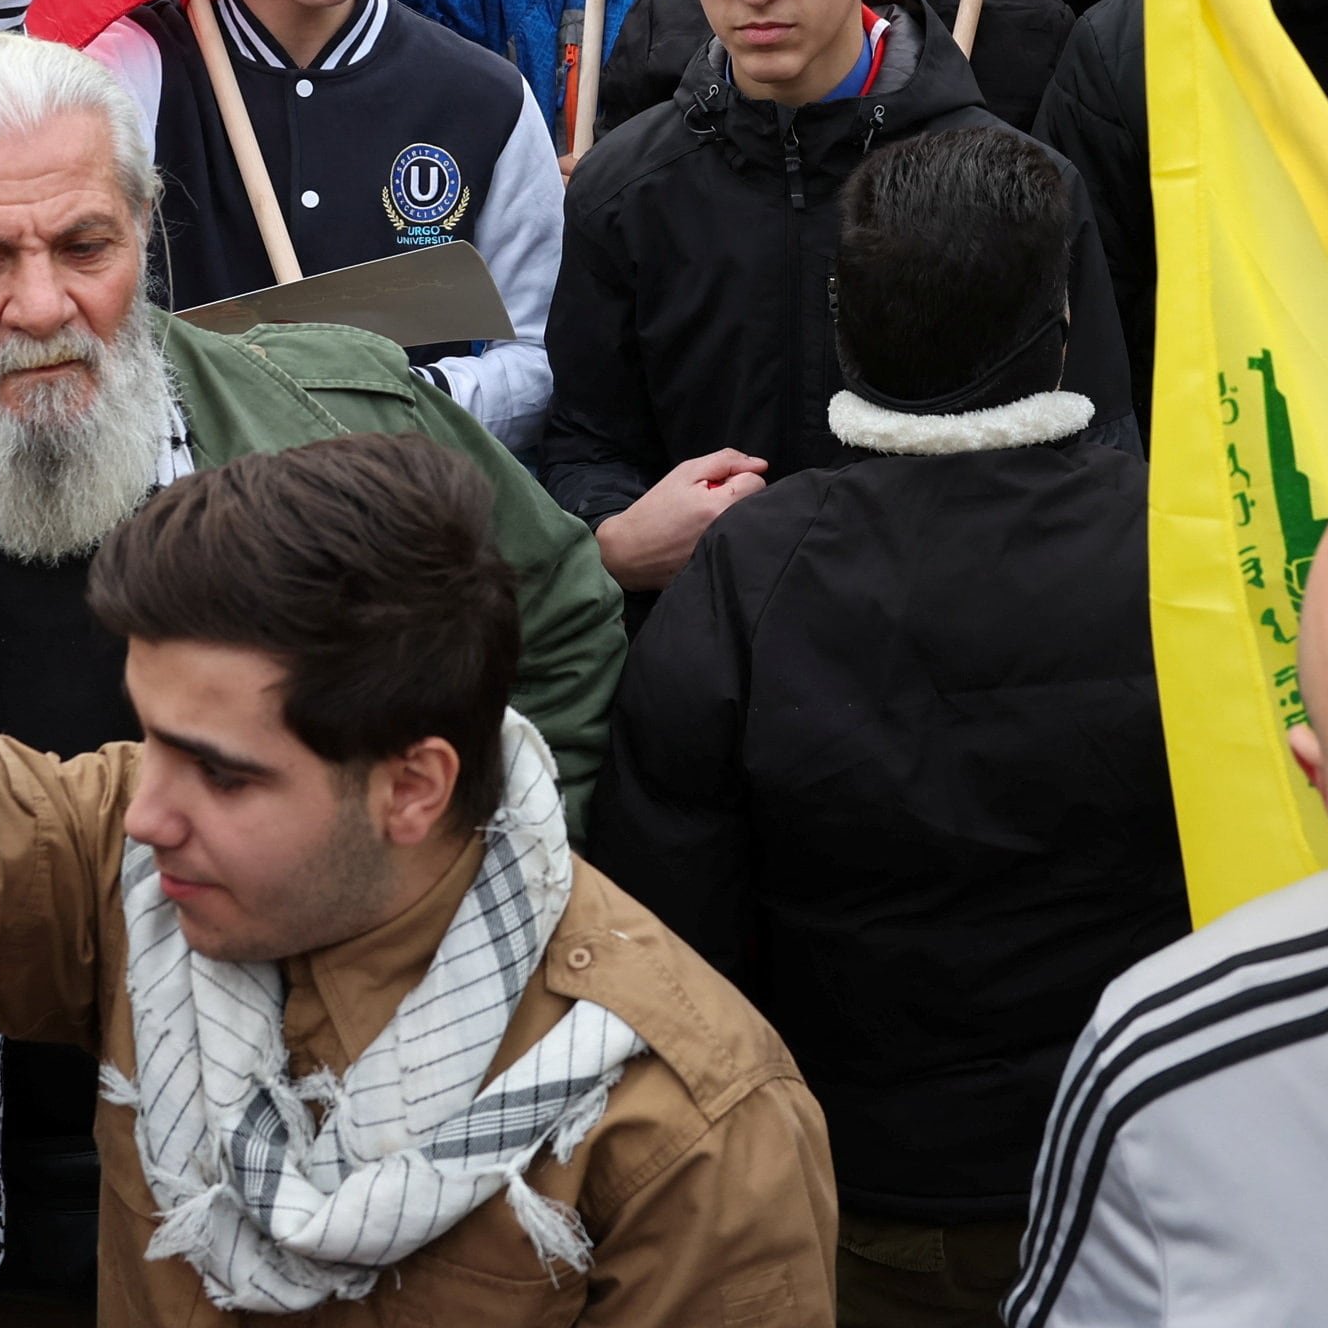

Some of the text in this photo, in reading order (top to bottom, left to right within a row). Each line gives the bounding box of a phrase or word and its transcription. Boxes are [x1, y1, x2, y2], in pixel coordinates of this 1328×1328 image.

[443, 160, 455, 172] OF
[410, 165, 439, 202] U
[407, 225, 441, 236] URGO
[396, 234, 454, 245] UNIVERSITY
